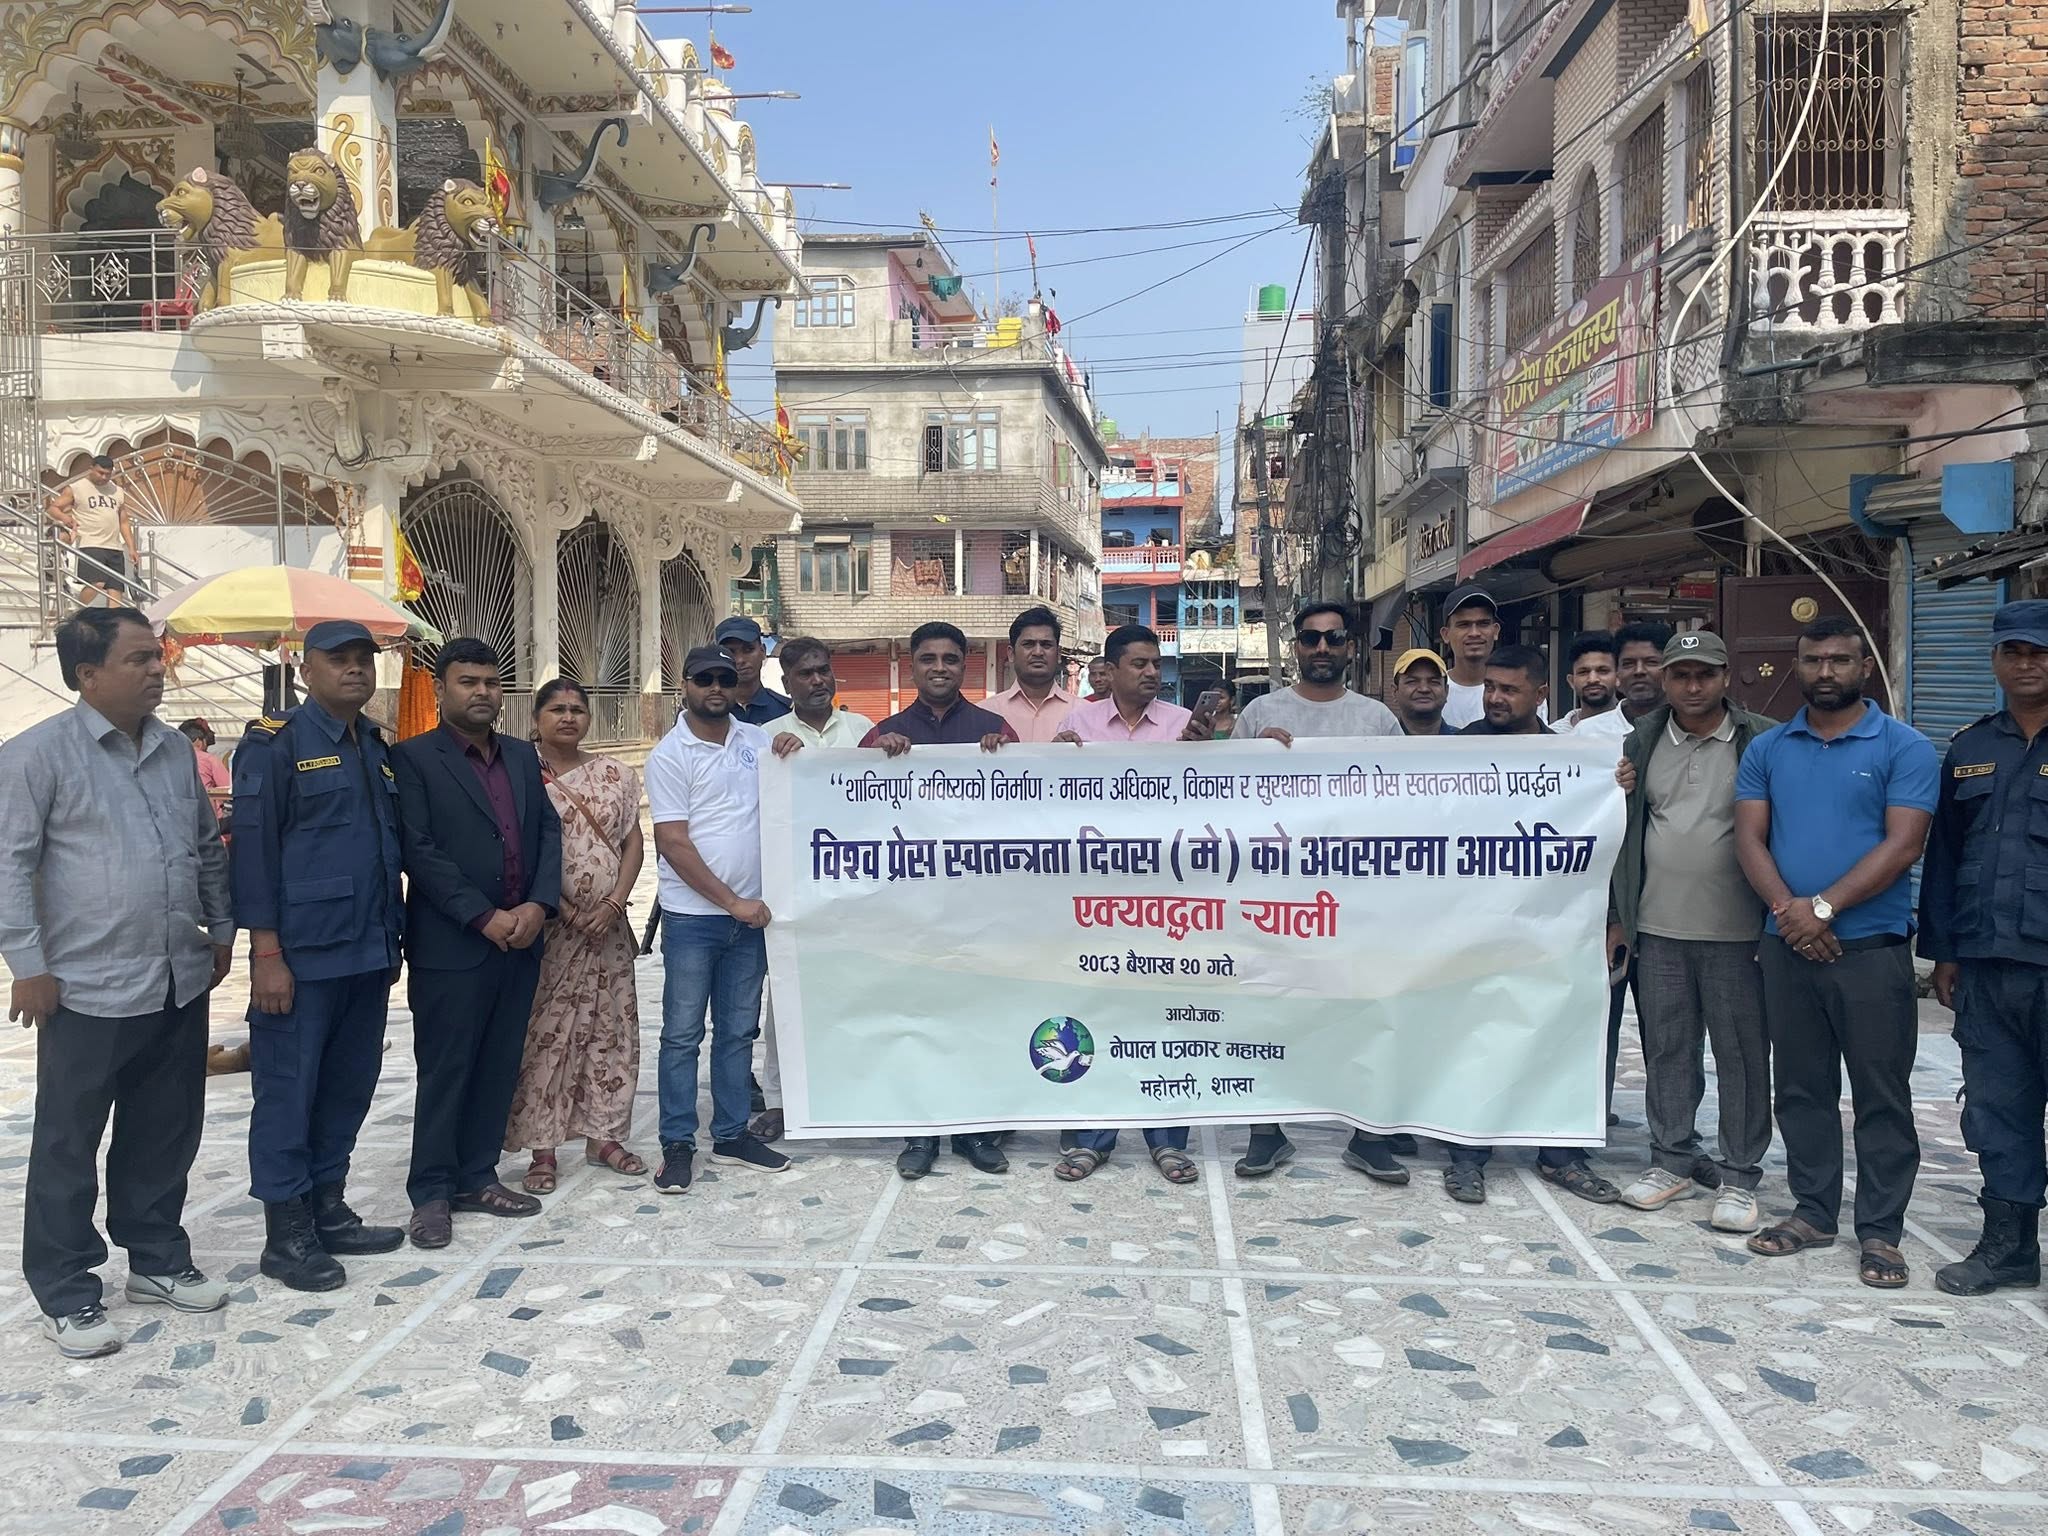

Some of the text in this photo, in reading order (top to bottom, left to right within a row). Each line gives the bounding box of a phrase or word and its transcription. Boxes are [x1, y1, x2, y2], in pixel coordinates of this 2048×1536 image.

[1503, 357, 1541, 418] राजेश
[88, 495, 117, 509] GAP
[918, 769, 985, 801] भविष्यको
[990, 769, 1043, 801] निर्माण
[1059, 777, 1104, 801] मानव
[1109, 768, 1177, 805] अधिकार,
[1183, 767, 1233, 800] विकास
[1239, 775, 1250, 798] र
[1255, 774, 1322, 806] सुरक्षाका
[1327, 765, 1367, 797] लागि
[1372, 765, 1400, 799] प्रेस
[1405, 763, 1501, 797] स्वतन्त्रताको
[810, 828, 882, 882] विश्व
[887, 825, 937, 883] प्रेस
[942, 838, 1071, 878] स्वतन्त्रता
[1076, 826, 1162, 876] दिवस
[1249, 822, 1292, 877] को
[1300, 836, 1449, 878] अवसरमा
[1457, 820, 1597, 878] आयोजित
[1079, 954, 1120, 975] २०८३
[1180, 957, 1200, 976] २०
[1109, 1035, 1286, 1060] नेपाल पत्रकार महासंघ
[1211, 1077, 1255, 1097] शाखा
